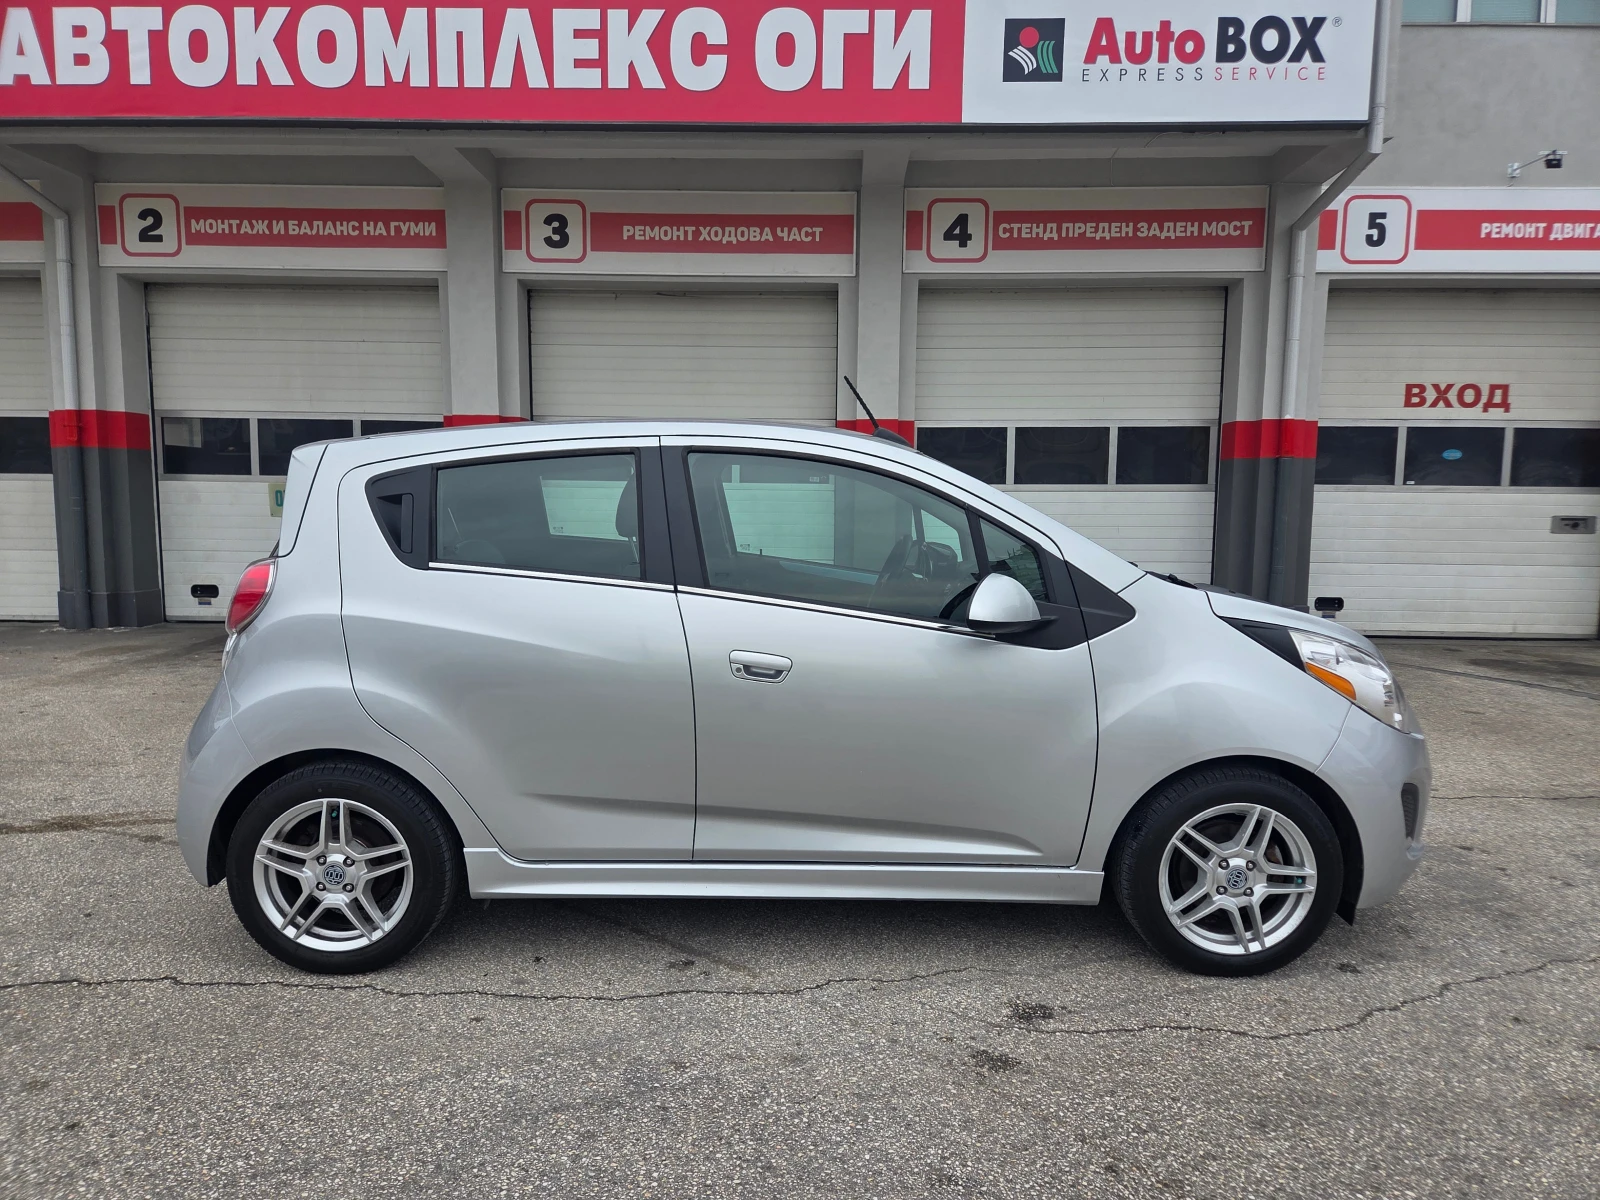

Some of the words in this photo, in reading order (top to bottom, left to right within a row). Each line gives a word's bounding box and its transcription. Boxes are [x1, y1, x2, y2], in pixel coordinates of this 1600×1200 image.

[0, 4, 728, 91] АВТОКОМПЛЕКС
[755, 7, 932, 91] ОГИ
[1083, 17, 1205, 65] Auto
[1215, 15, 1327, 64] BOX
[1081, 67, 1203, 82] EXPRESS
[1214, 66, 1326, 81] SERVICE
[137, 207, 163, 243] 2
[190, 219, 270, 235] МОНТАЖ
[272, 220, 285, 235] И
[288, 220, 360, 236] БАЛАНС
[362, 221, 387, 237] НА
[390, 221, 437, 237] ГУМИ
[542, 213, 570, 249] 3
[622, 225, 696, 241] РЕМОНТ
[699, 226, 774, 245] ХОДОВА
[776, 226, 824, 242] ЧАСТ
[942, 213, 973, 248] 4
[998, 223, 1059, 241] СТЕНД
[1061, 222, 1134, 240] ПРЕДЕН
[1136, 221, 1199, 239] ЗАДЕН
[1202, 220, 1253, 236] МОСТ
[1365, 212, 1388, 248] 5
[1480, 222, 1548, 239] РЕМОНТ
[1403, 383, 1511, 413] ВХОД
